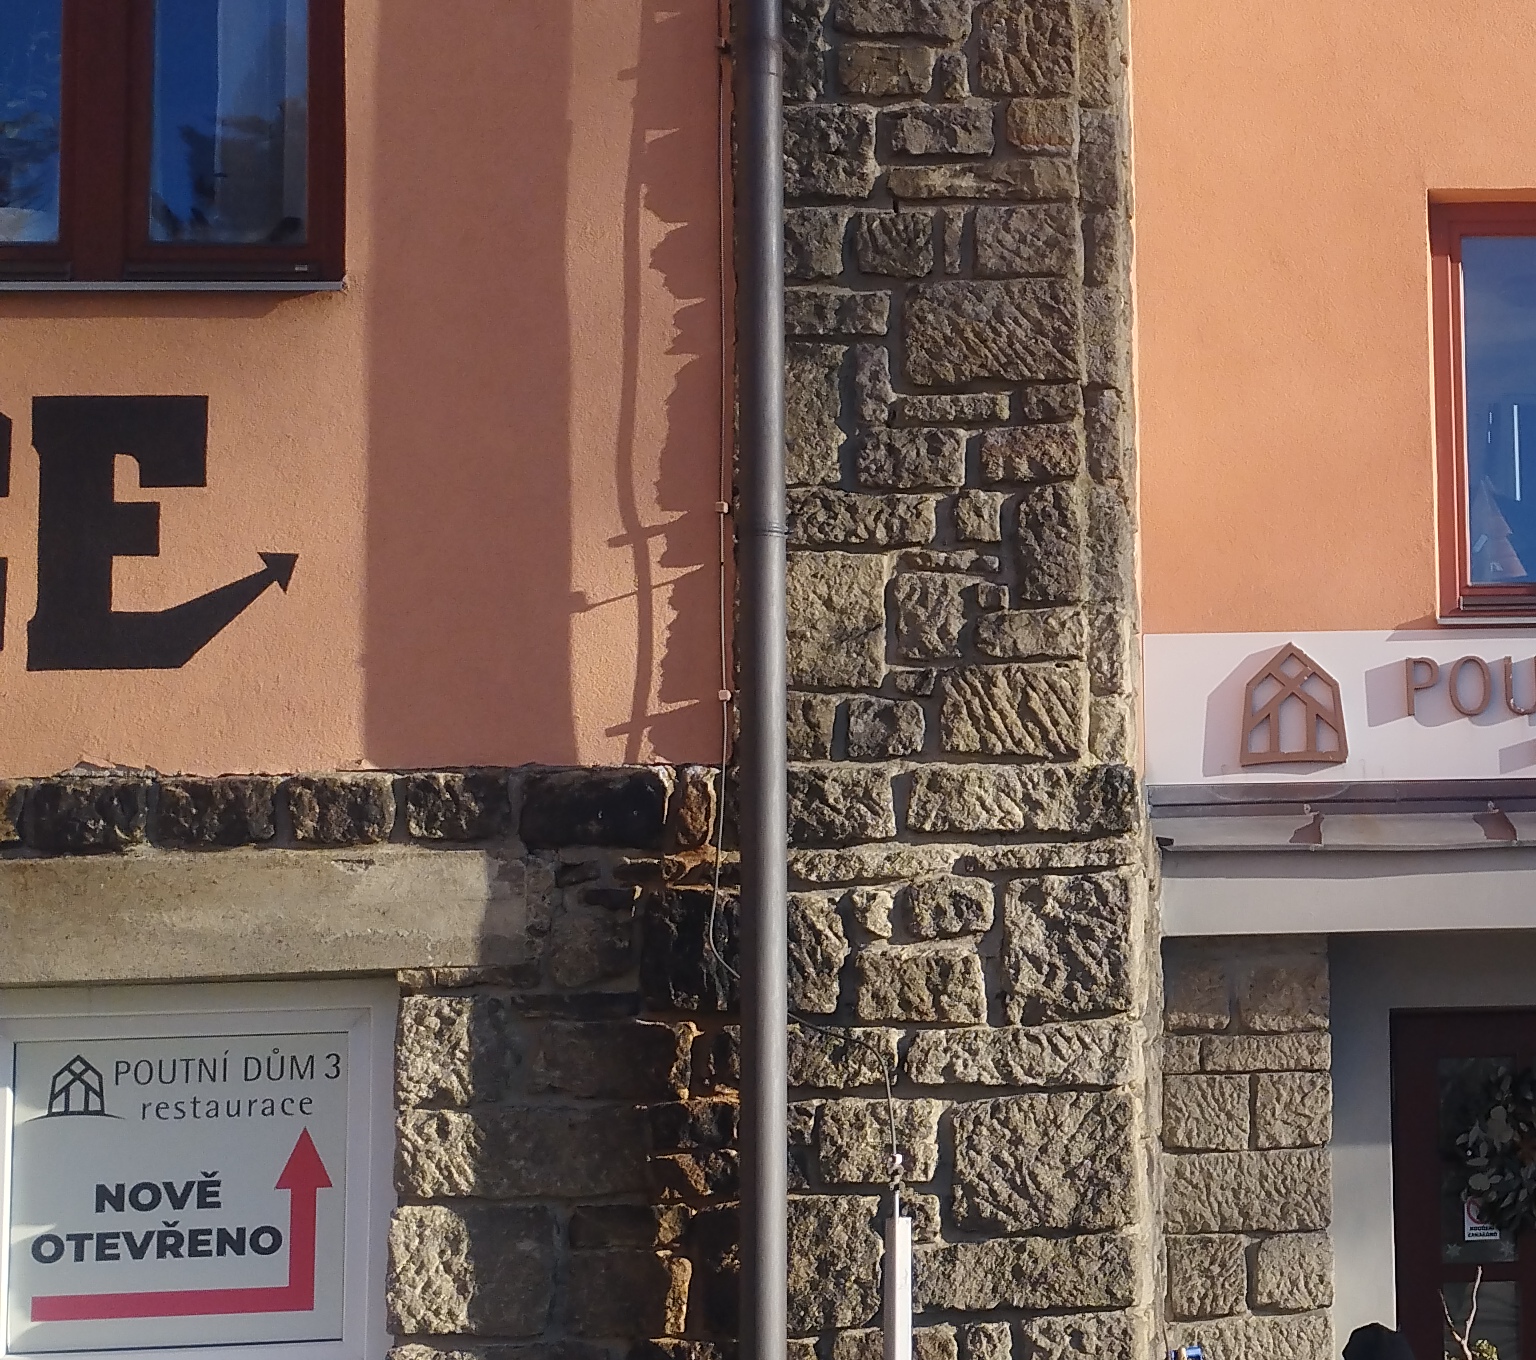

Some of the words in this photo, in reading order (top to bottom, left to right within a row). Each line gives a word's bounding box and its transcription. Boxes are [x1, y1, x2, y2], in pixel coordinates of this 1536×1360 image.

[114, 1049, 229, 1086] POUTNÍ
[243, 1047, 315, 1083] DŮM
[324, 1052, 342, 1080] 3
[140, 1096, 314, 1121] restaurace
[94, 1169, 223, 1214] NOVĚ
[30, 1220, 284, 1265] OTEVŘENO
